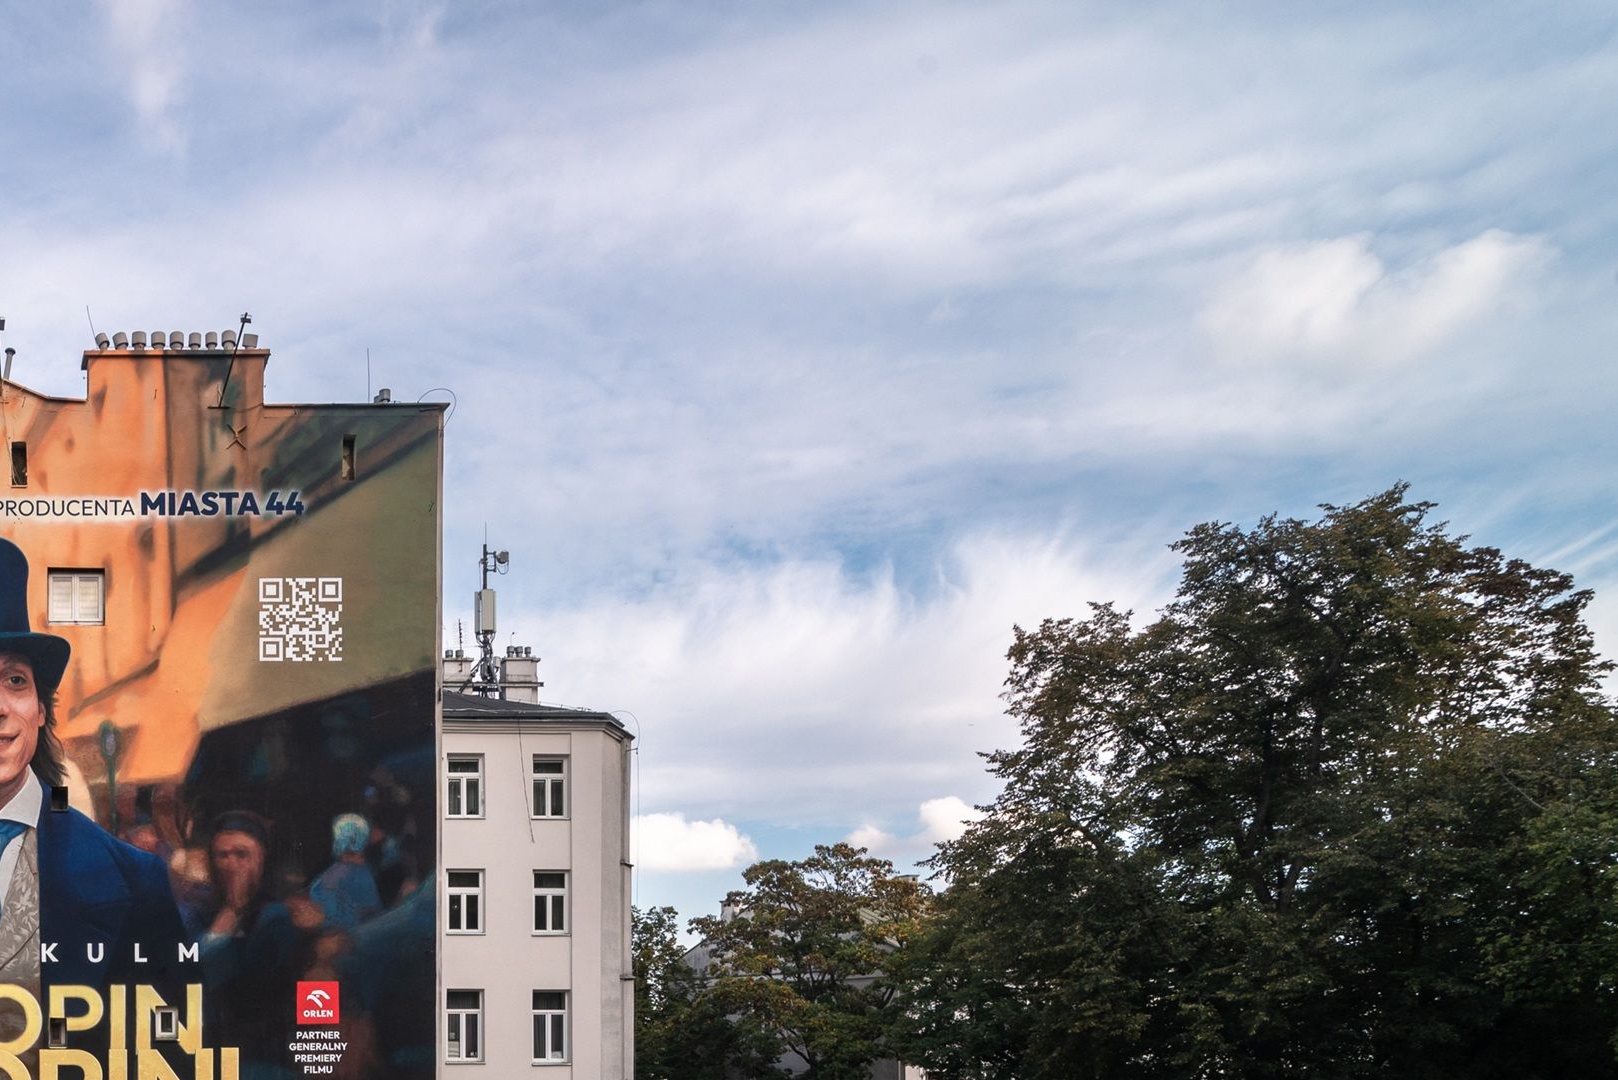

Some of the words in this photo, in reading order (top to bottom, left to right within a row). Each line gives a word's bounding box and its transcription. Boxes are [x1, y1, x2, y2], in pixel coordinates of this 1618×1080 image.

[140, 491, 260, 516] MIASTA
[265, 491, 305, 516] 44
[40, 942, 199, 964] KULM
[303, 1009, 334, 1018] ORLEN
[296, 1031, 340, 1040] PARTNER
[288, 1042, 348, 1051] GENERALNY
[294, 1053, 342, 1062] PREMIERY
[304, 1065, 334, 1074] FILMU
